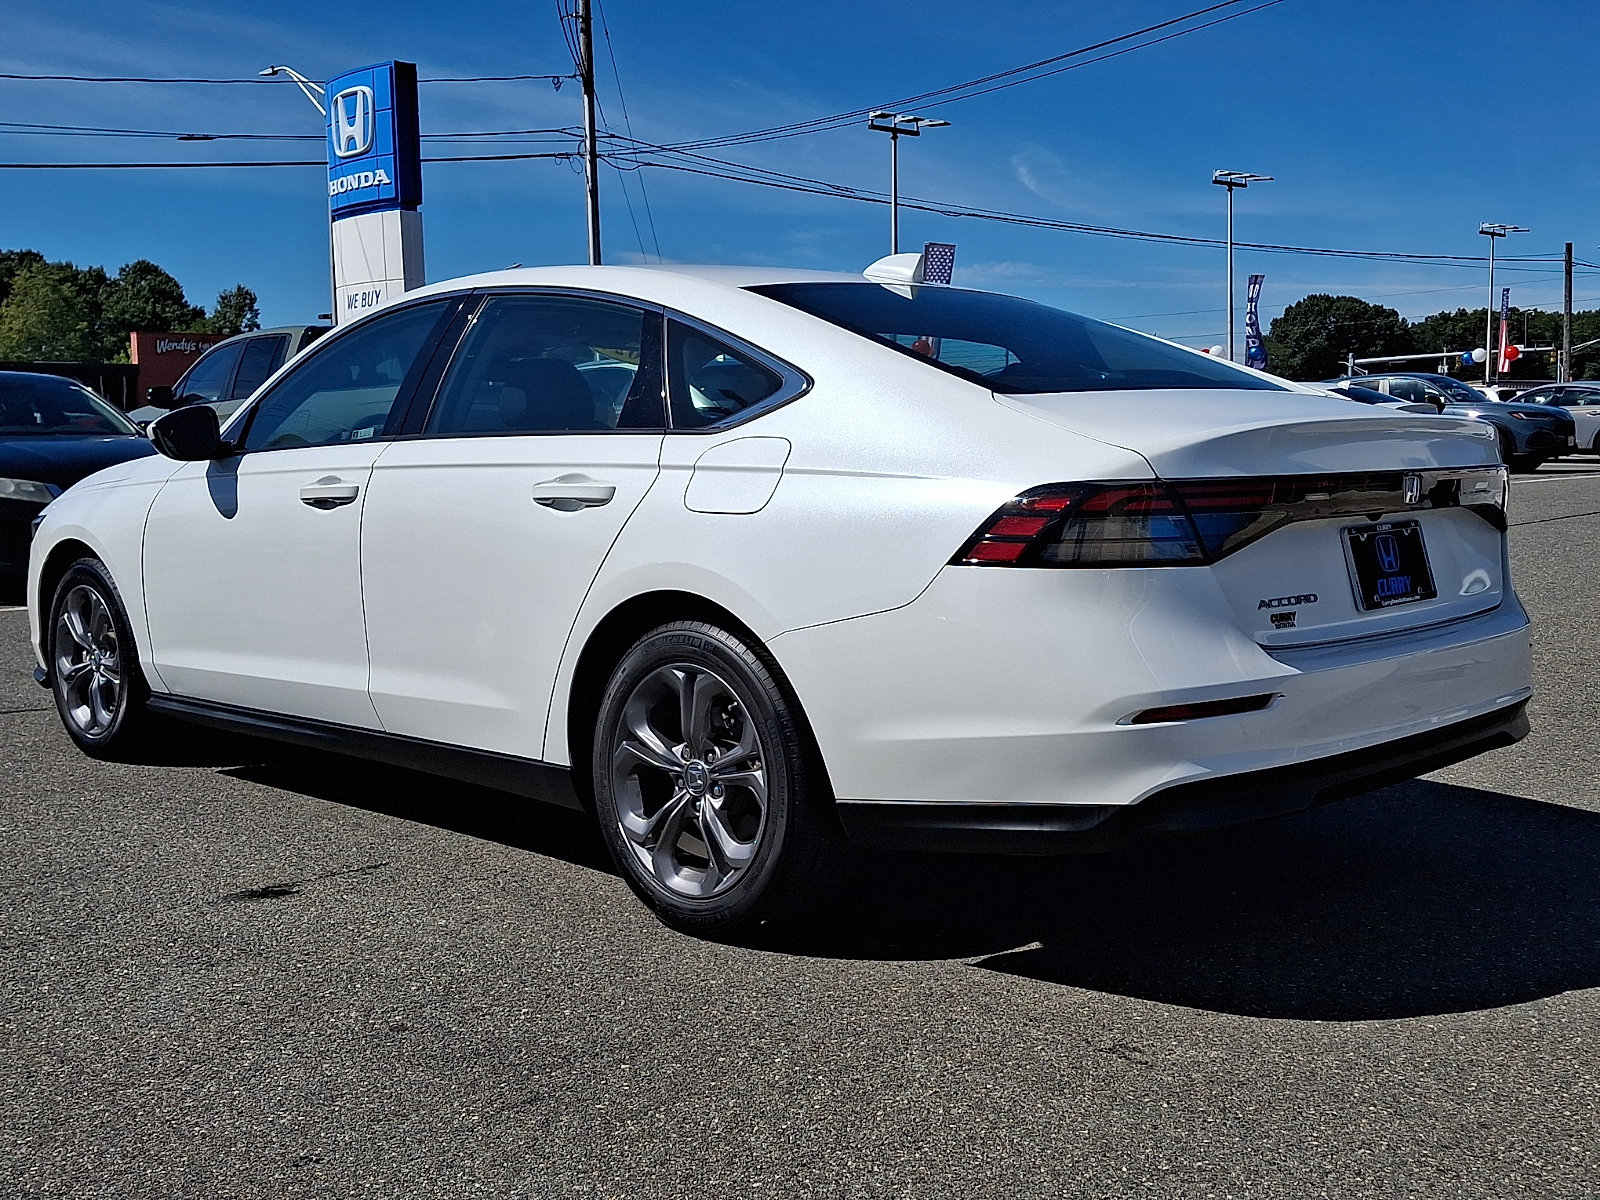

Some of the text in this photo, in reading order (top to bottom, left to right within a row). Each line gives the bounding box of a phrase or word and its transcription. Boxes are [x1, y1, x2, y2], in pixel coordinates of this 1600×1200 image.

[329, 169, 391, 196] HONDA
[347, 289, 382, 310] WE BUY
[156, 338, 197, 354] Wendy's
[1377, 575, 1411, 596] CURRY
[1257, 593, 1319, 610] ACCORD
